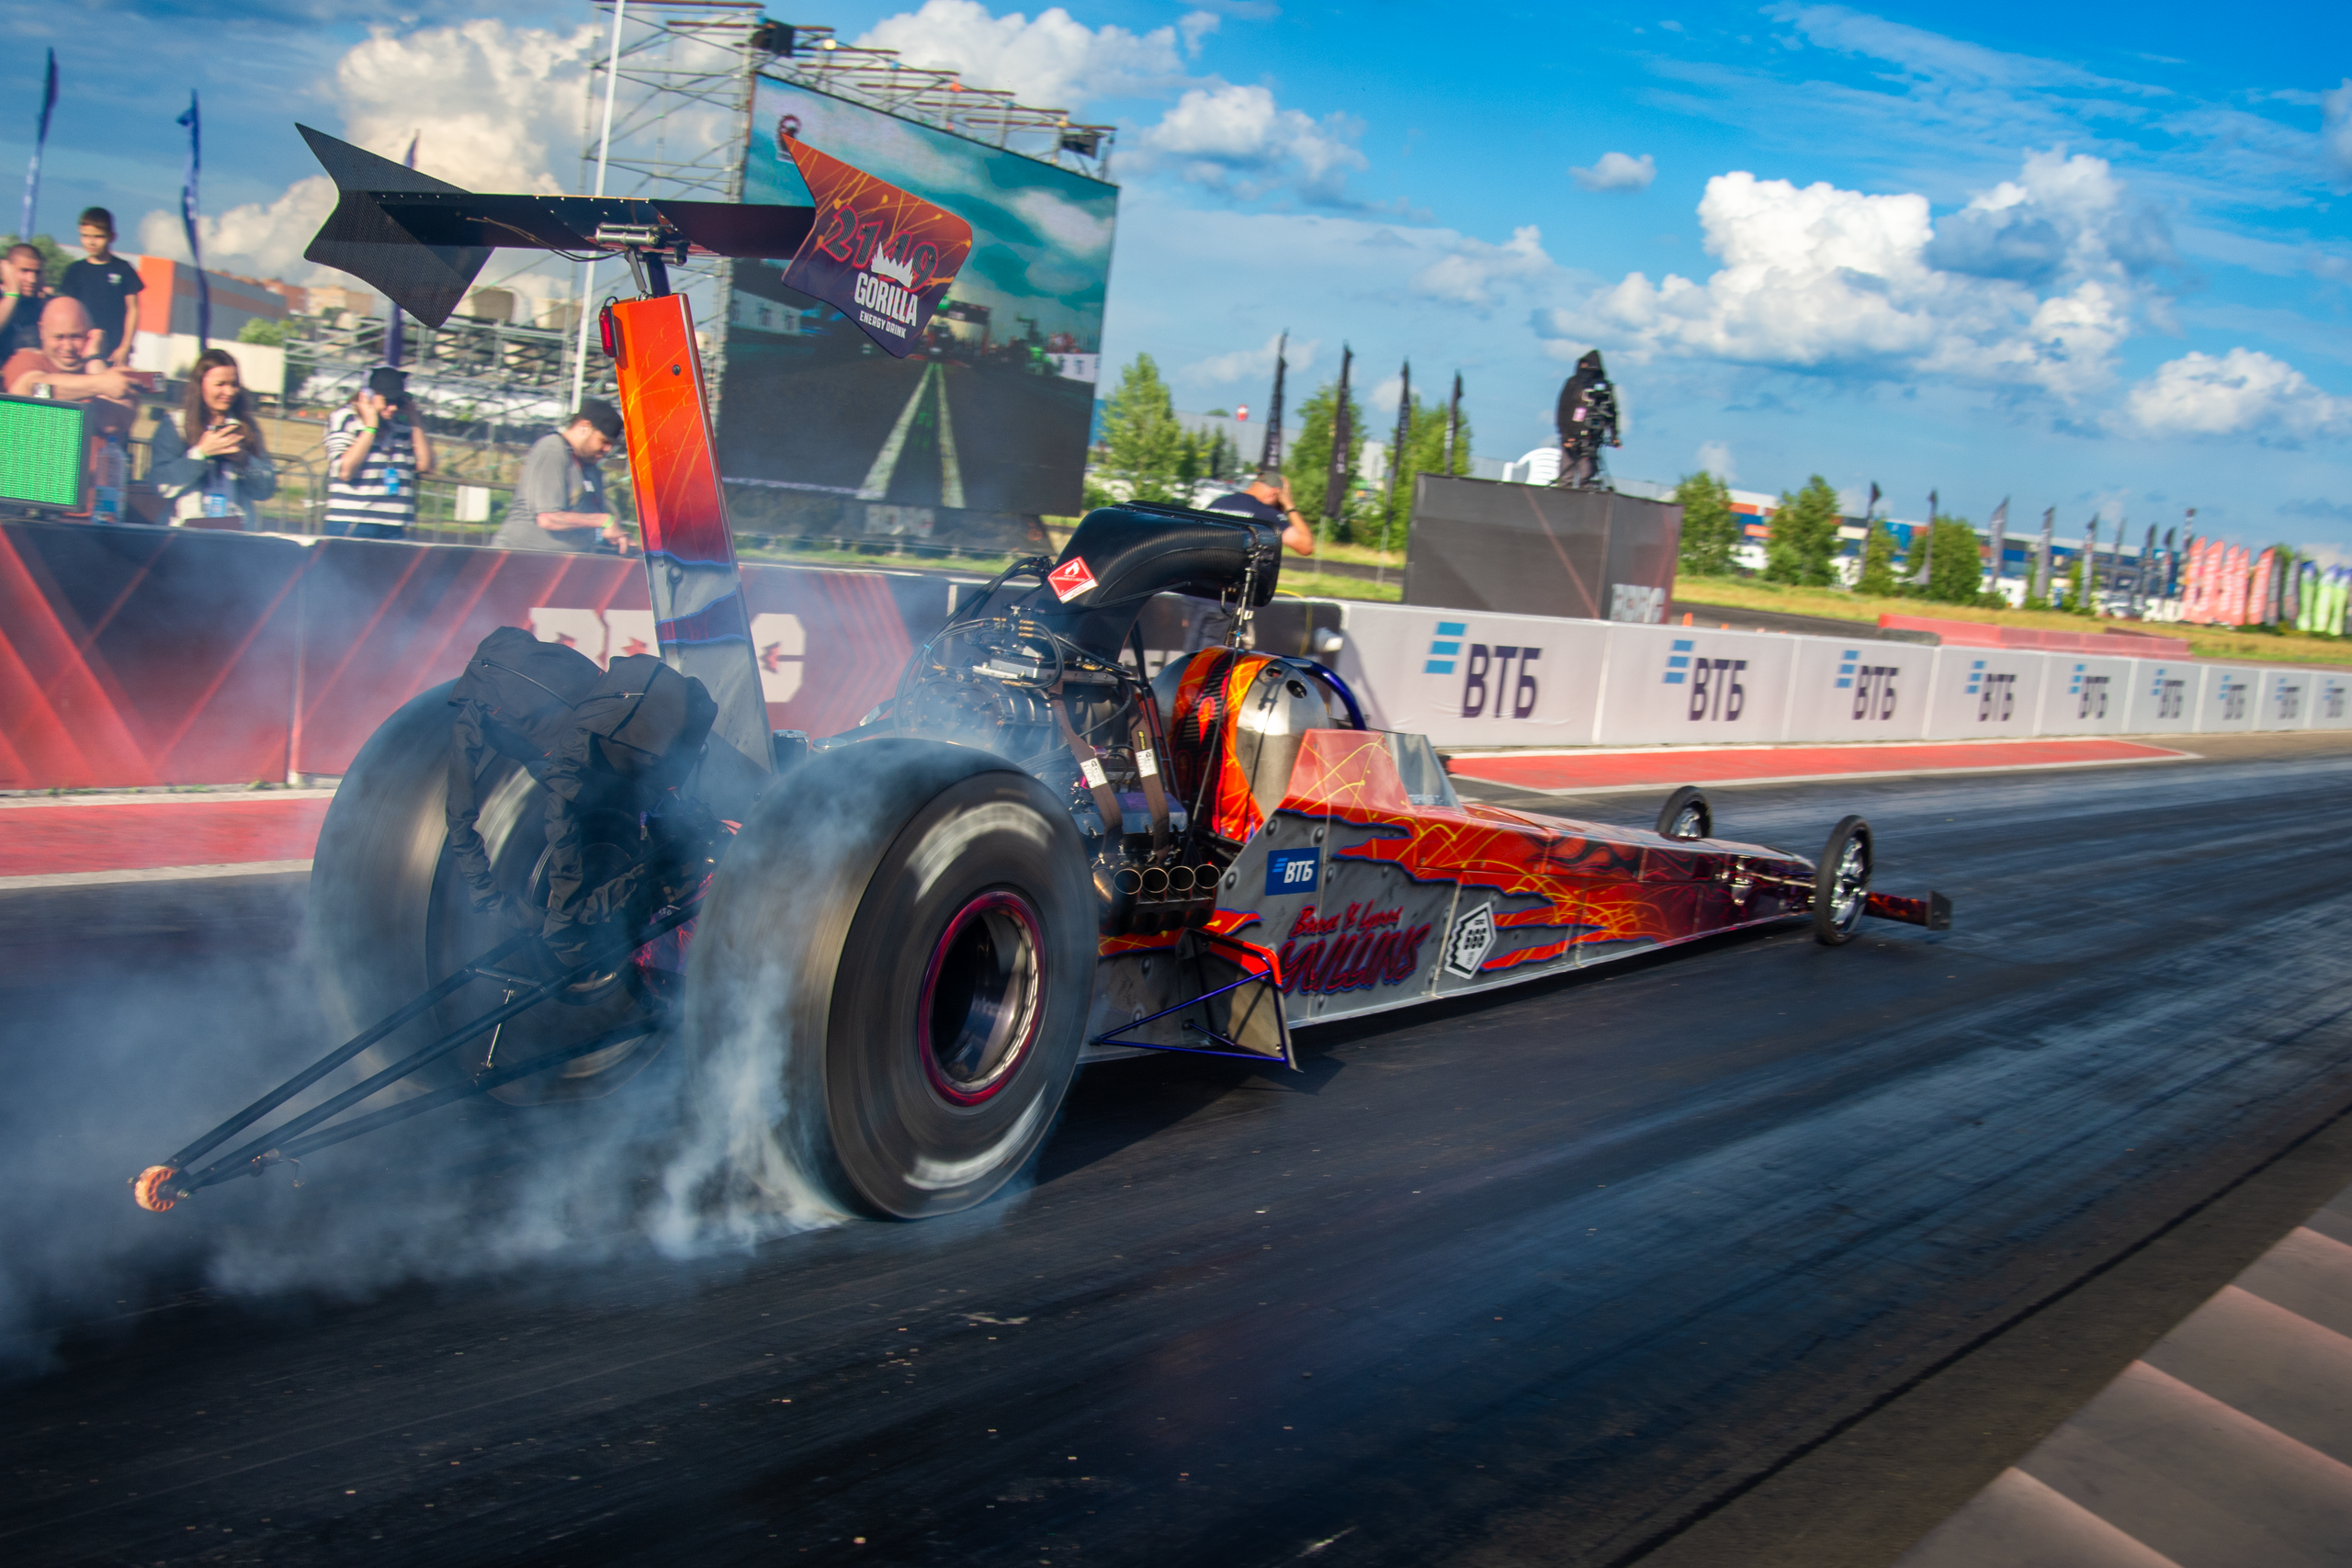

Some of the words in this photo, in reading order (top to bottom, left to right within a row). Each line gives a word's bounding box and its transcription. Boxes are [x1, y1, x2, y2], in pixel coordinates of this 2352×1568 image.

[854, 272, 918, 327] GORILLA
[859, 310, 887, 330] ENERGY
[885, 319, 907, 339] DRINK
[1461, 643, 1543, 719] ВТБ
[1688, 657, 1747, 721] ВТБ
[1851, 665, 1899, 720] ВТБ
[1978, 673, 2018, 722] ВТБ
[1283, 860, 1315, 884] ВТБ
